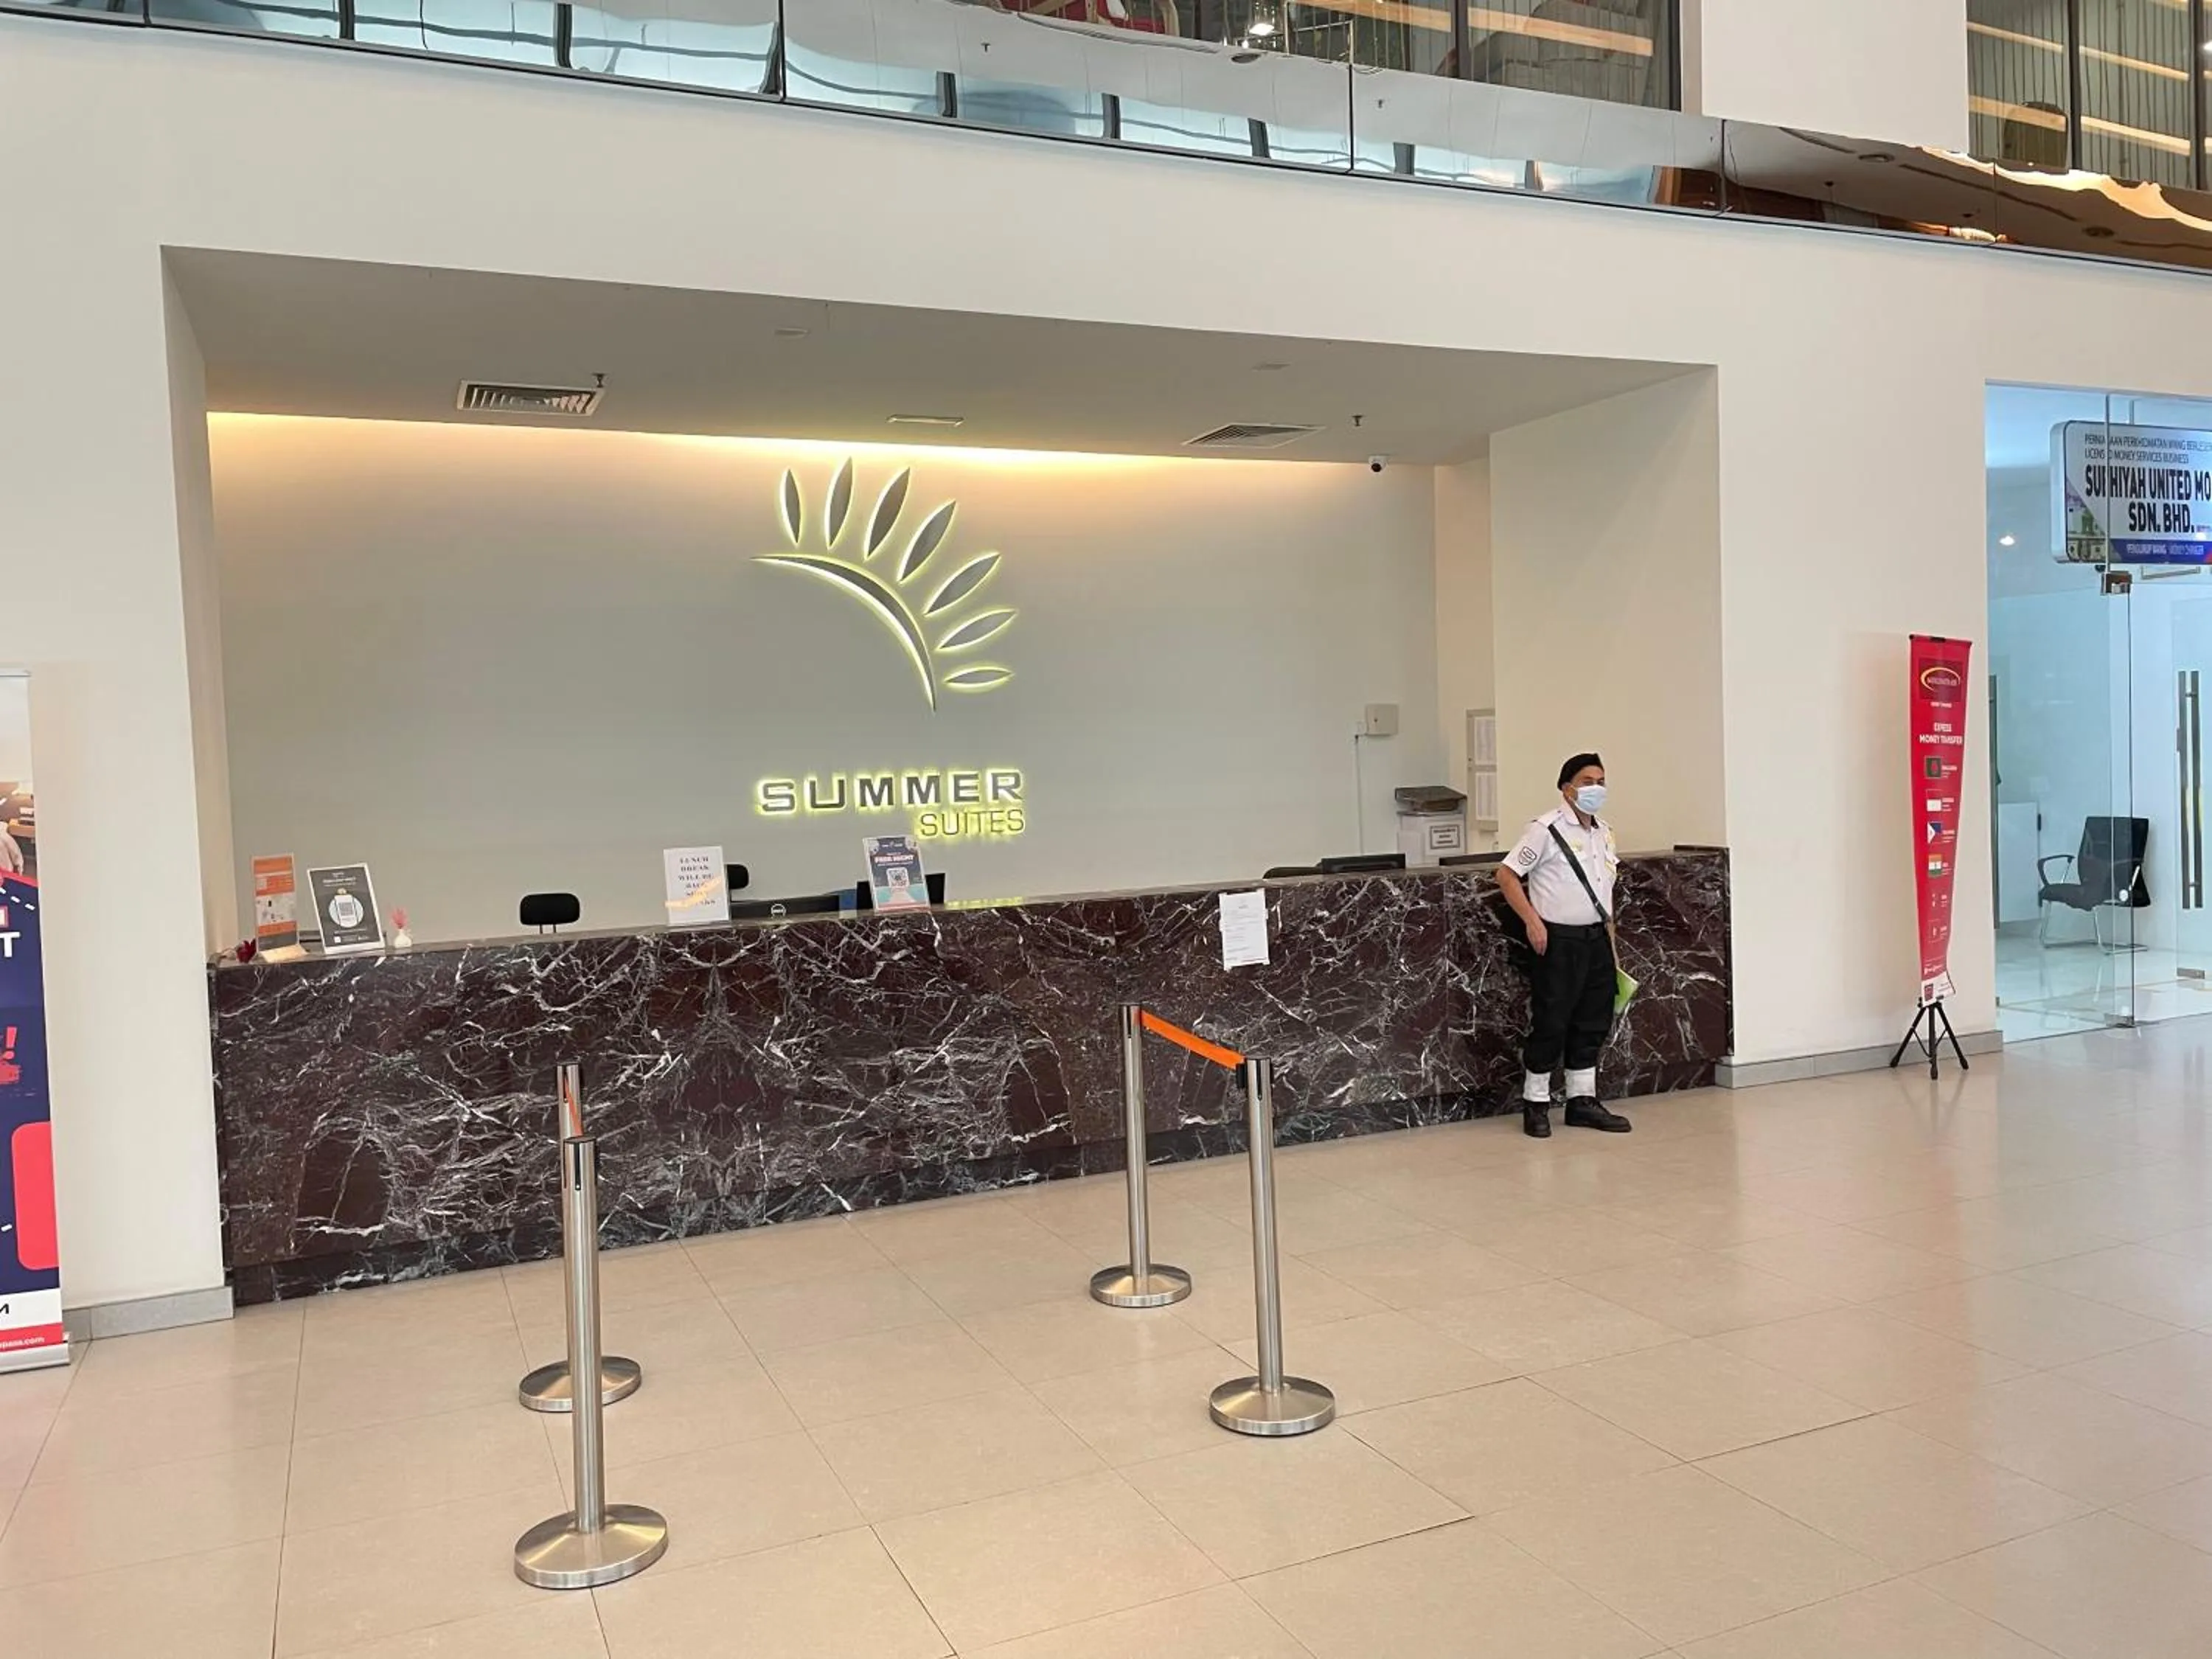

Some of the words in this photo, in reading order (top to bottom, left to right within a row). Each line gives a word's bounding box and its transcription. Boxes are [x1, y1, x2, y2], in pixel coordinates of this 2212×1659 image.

[2085, 448, 2112, 459] LICENSD
[2149, 467, 2192, 500] UNITED
[2129, 502, 2160, 532] SDN.
[2163, 503, 2195, 533] BHD.
[762, 771, 1023, 813] SUMMER
[919, 809, 1025, 837] SUITES
